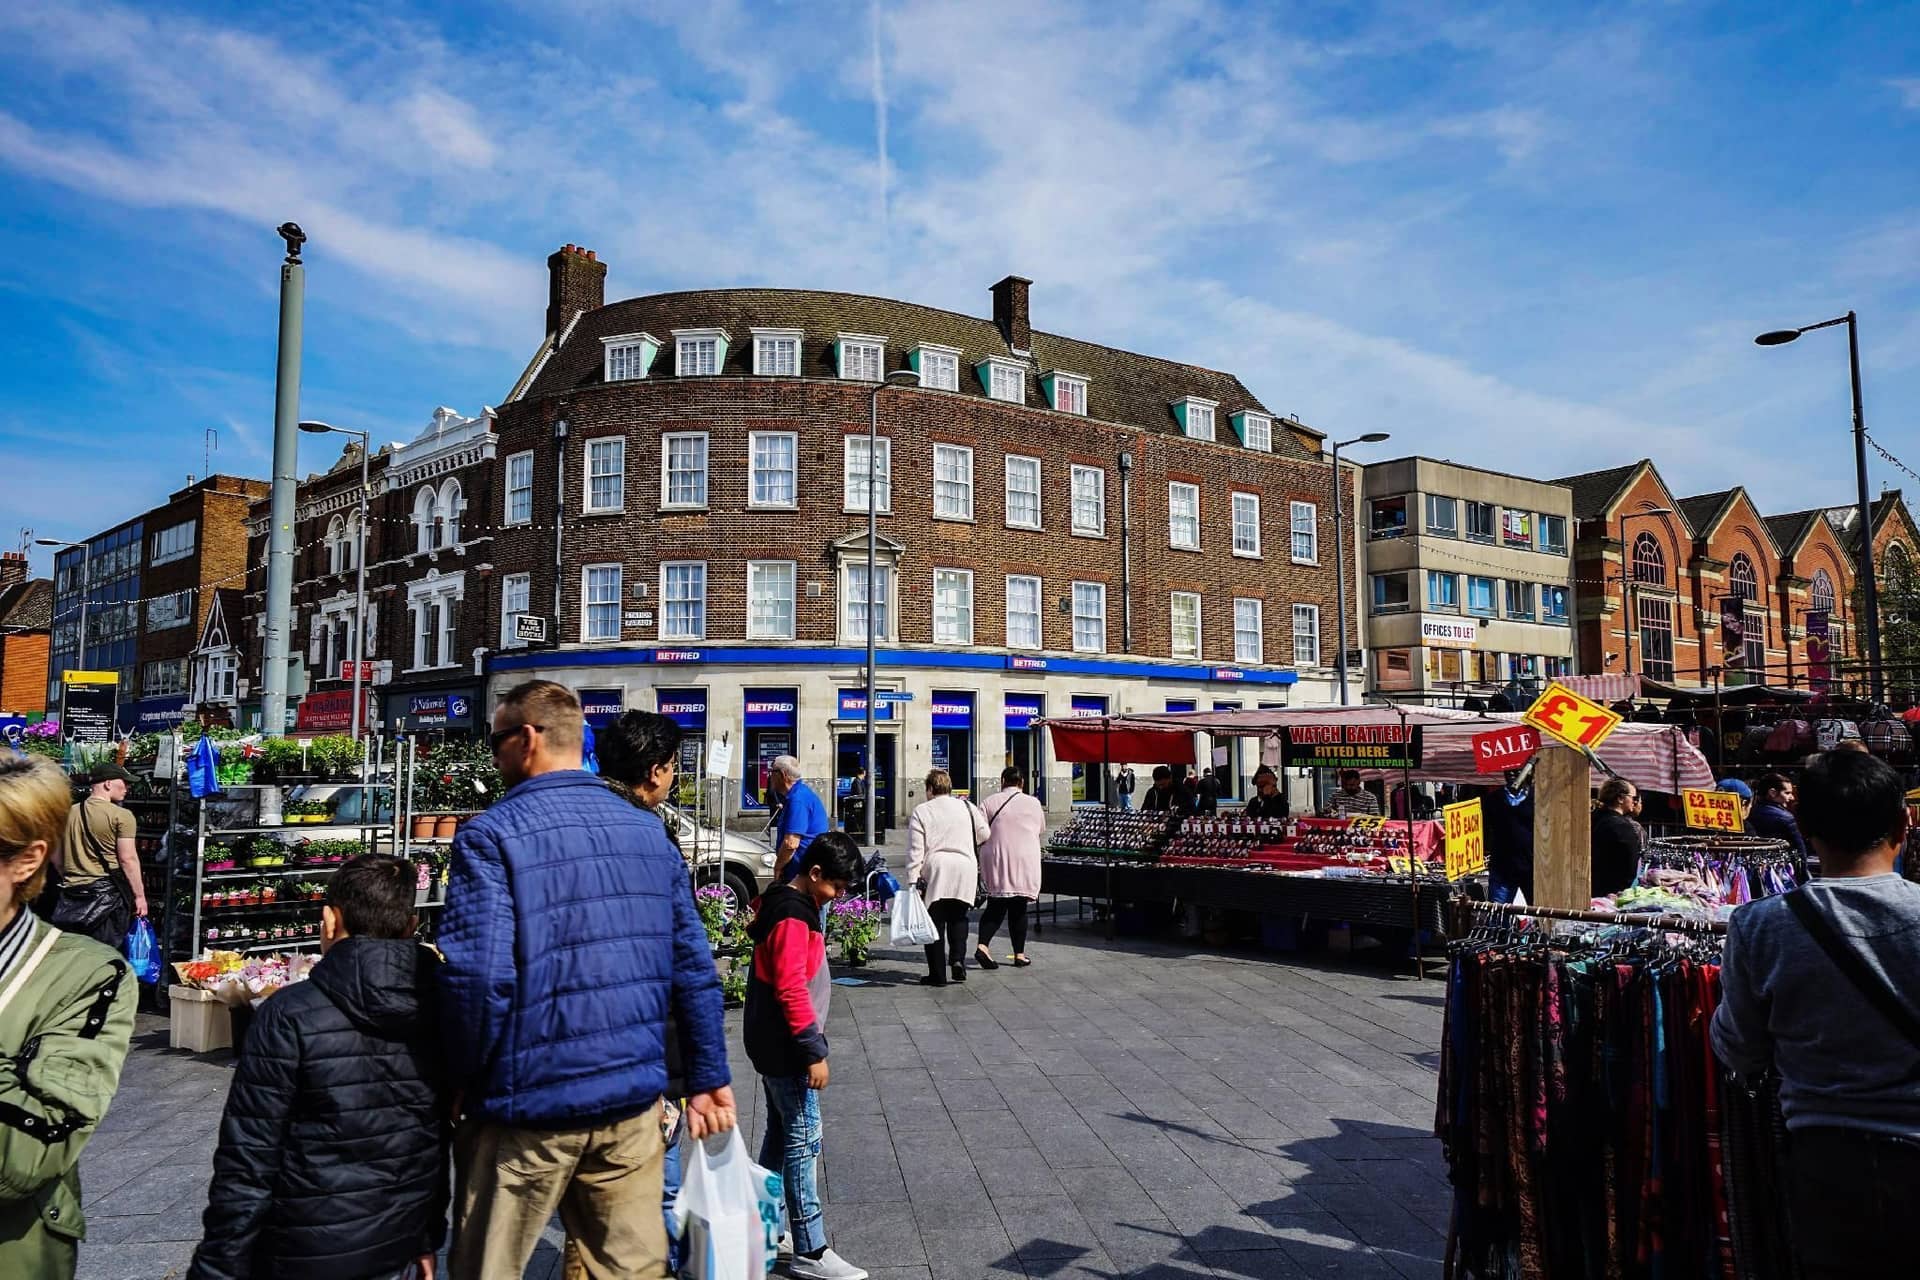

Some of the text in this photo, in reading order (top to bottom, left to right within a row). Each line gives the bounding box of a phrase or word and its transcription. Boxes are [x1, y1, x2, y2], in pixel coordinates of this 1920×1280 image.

[1424, 623, 1474, 639] OFFICES TO LET
[656, 651, 700, 661] BETFRED
[1013, 658, 1047, 668] BETFRED
[583, 704, 623, 714] BETFRED
[661, 703, 706, 713] BETFRED
[746, 703, 794, 712] BETFRED
[931, 705, 970, 714] BETFRED
[1003, 706, 1039, 715] BETFRED
[1534, 695, 1611, 744] £1
[1289, 725, 1413, 744] WATCH BATTERY
[1481, 732, 1534, 758] SALE
[1315, 746, 1390, 758] FITTED HERE
[1292, 758, 1308, 766] ALL
[1340, 759, 1374, 767] WATCH
[1689, 793, 1734, 811] £2 EACH
[1450, 811, 1479, 839] £6 EACH
[1694, 811, 1734, 827] 3 for £5
[1450, 836, 1481, 870] 2 for £10
